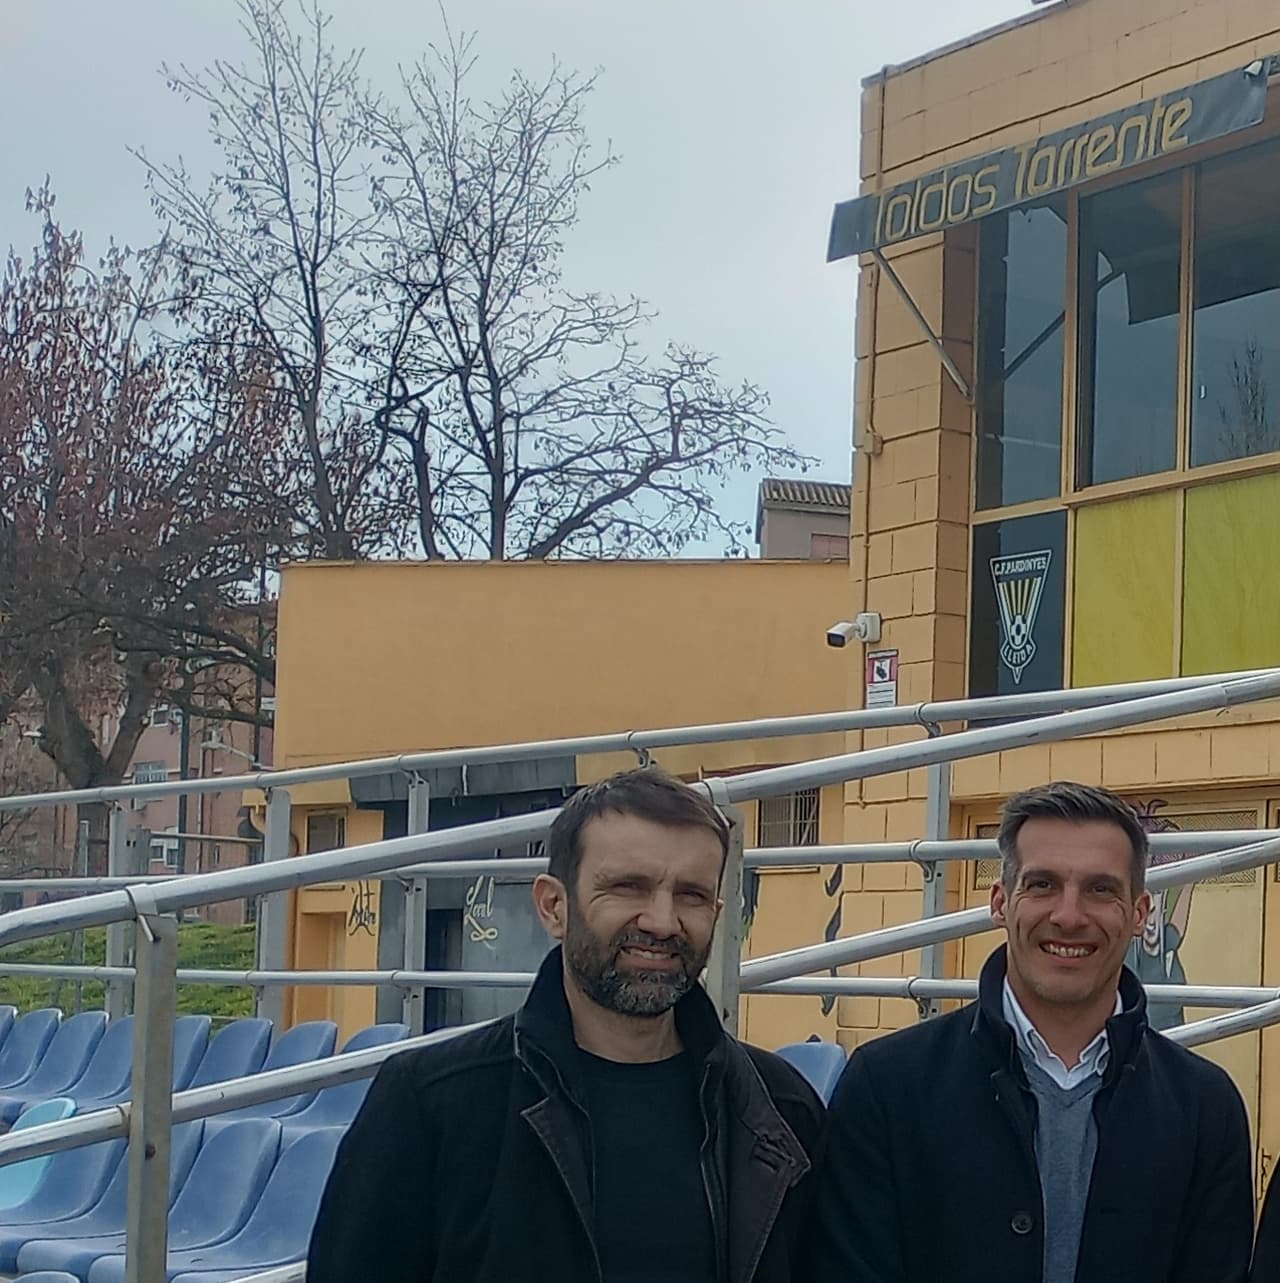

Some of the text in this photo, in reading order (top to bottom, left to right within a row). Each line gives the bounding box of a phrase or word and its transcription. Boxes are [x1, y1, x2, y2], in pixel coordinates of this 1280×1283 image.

[874, 97, 1193, 244] Toldos Torrente
[1003, 643, 1033, 664] LLEIDA
